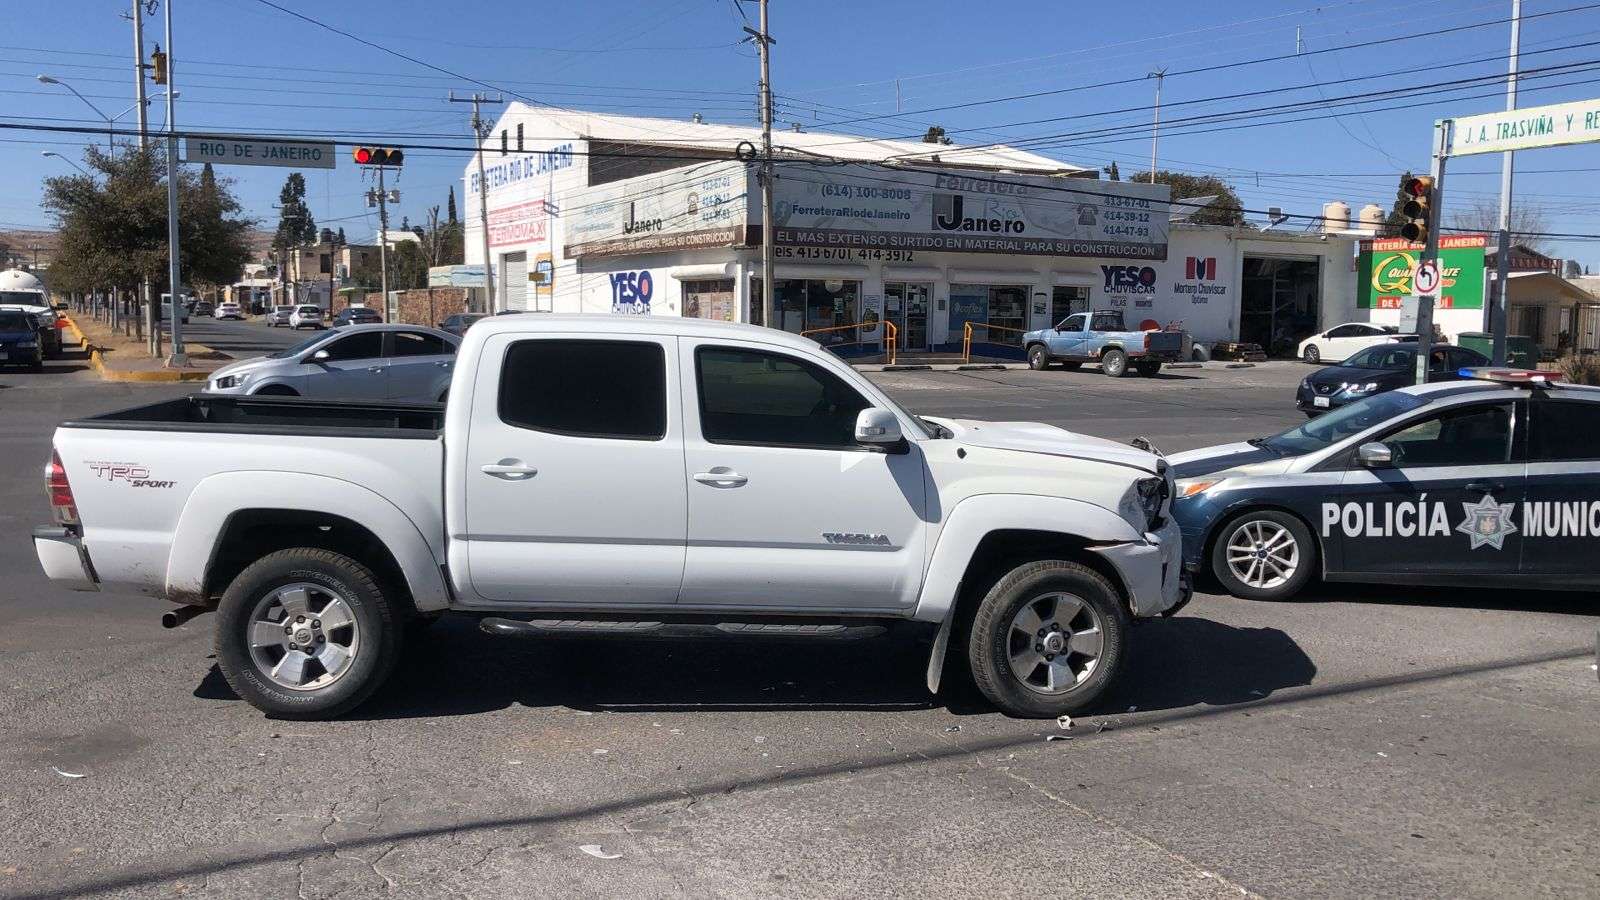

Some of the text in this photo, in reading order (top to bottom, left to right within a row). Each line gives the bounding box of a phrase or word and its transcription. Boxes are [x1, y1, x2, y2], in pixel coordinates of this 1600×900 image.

[1465, 127, 1474, 144] J.
[1480, 125, 1490, 141] A.
[1497, 114, 1554, 140] TRASVIÑA
[1566, 113, 1574, 132] Y
[199, 142, 322, 161] RIO DE JANEIRO
[821, 184, 853, 199] (614)
[792, 204, 911, 220] FerreteraRiodeJaneiro
[1103, 210, 1150, 223] 414-39-12
[686, 230, 736, 245] CONSTRUCCION
[1102, 224, 1150, 237] 414-47-93
[776, 231, 1155, 257] EL MAS EXTENSO SURTIDO EN MATERIAL PARA SU CONSTRUCCION
[1443, 236, 1485, 249] JANEIRO
[1101, 264, 1157, 286] YESO
[608, 270, 653, 305] YESO
[1103, 284, 1156, 295] CHUVISCAR
[89, 464, 150, 482] TRD
[131, 480, 176, 489] SPORT
[1322, 493, 1451, 537] POLICÍA
[822, 532, 892, 546] TACOMA
